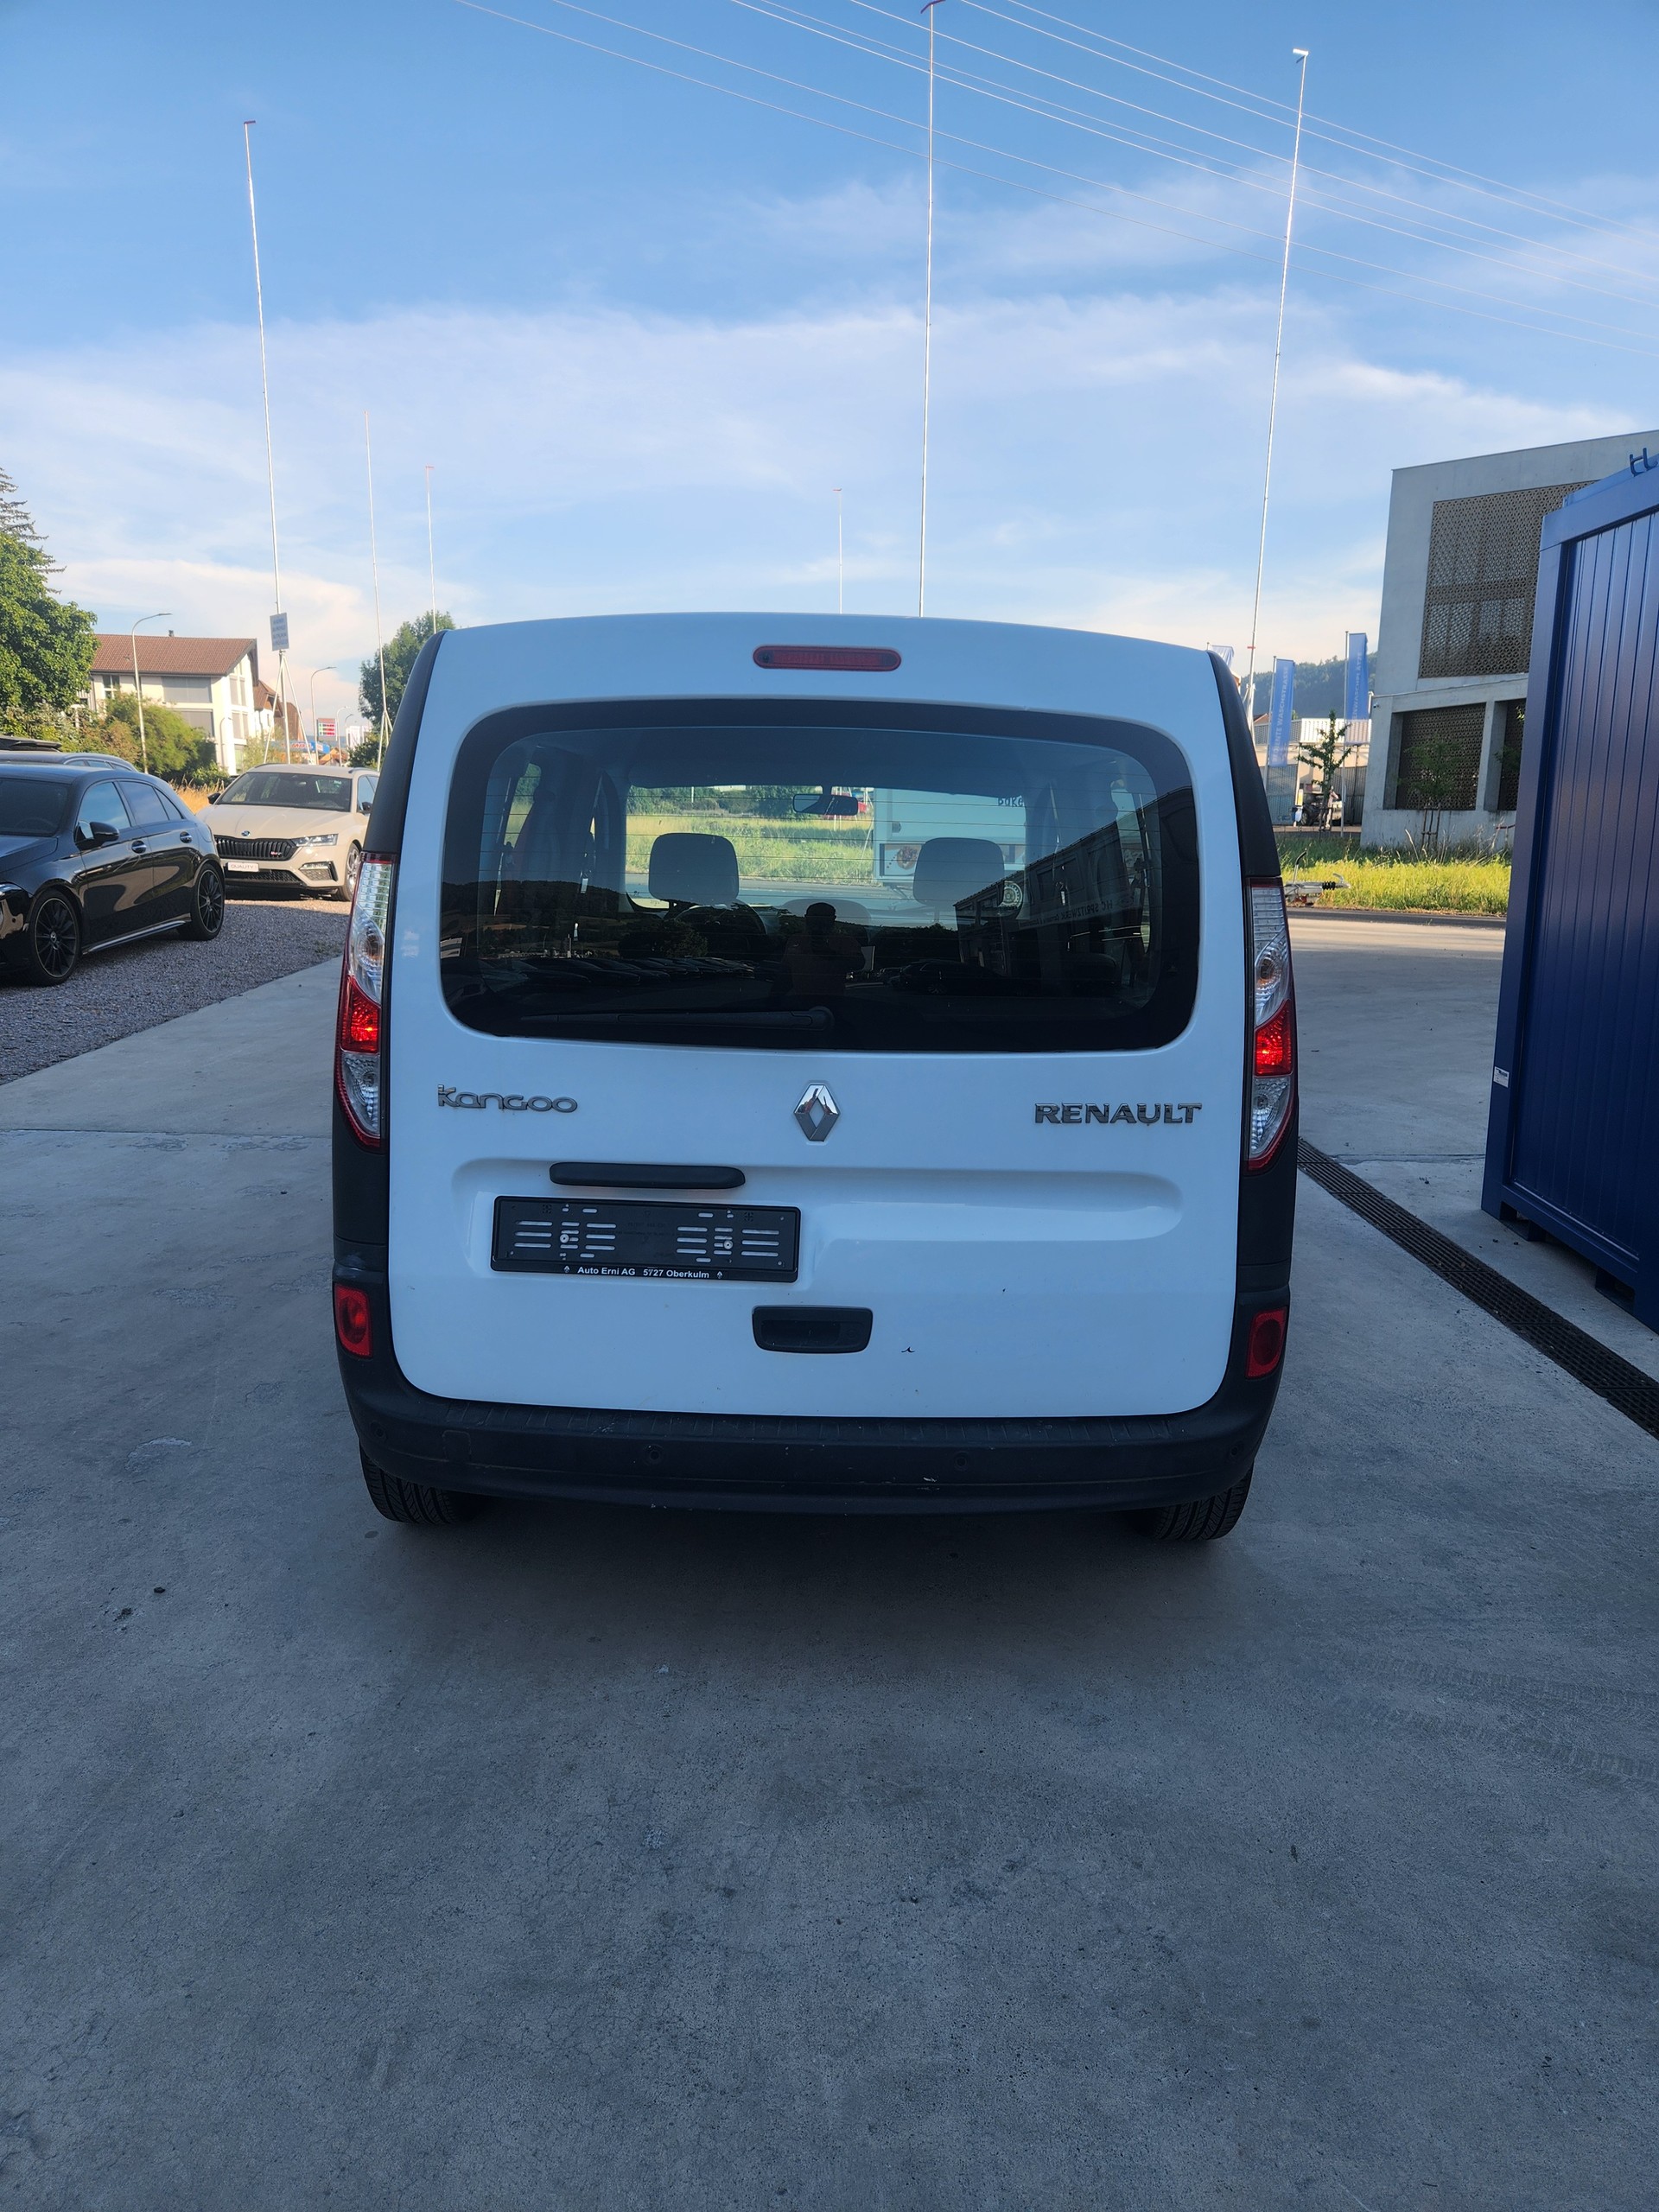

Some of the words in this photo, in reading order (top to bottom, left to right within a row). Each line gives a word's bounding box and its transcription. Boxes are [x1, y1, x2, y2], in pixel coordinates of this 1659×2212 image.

[1035, 1103, 1202, 1124] RENAULT
[643, 1268, 664, 1277] 5727
[666, 1269, 710, 1278] Oberkulm
